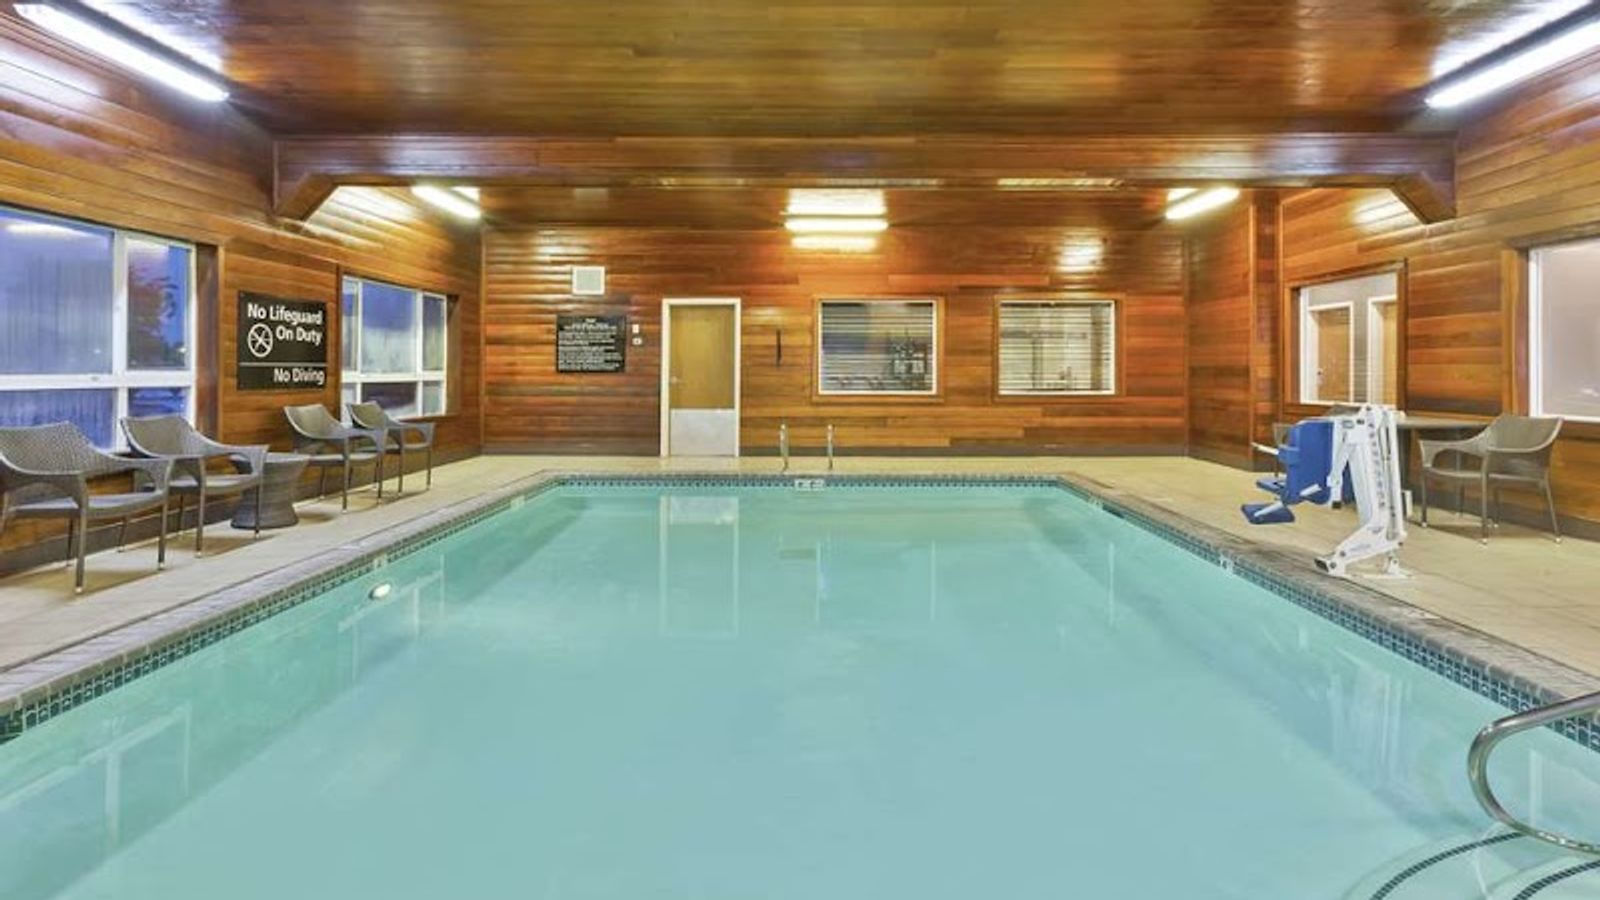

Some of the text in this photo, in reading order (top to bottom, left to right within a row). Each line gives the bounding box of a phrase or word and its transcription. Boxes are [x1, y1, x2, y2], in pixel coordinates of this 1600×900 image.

[247, 303, 323, 325] No Lifeguard
[276, 325, 322, 346] On Duty
[273, 368, 325, 385] No Diving
